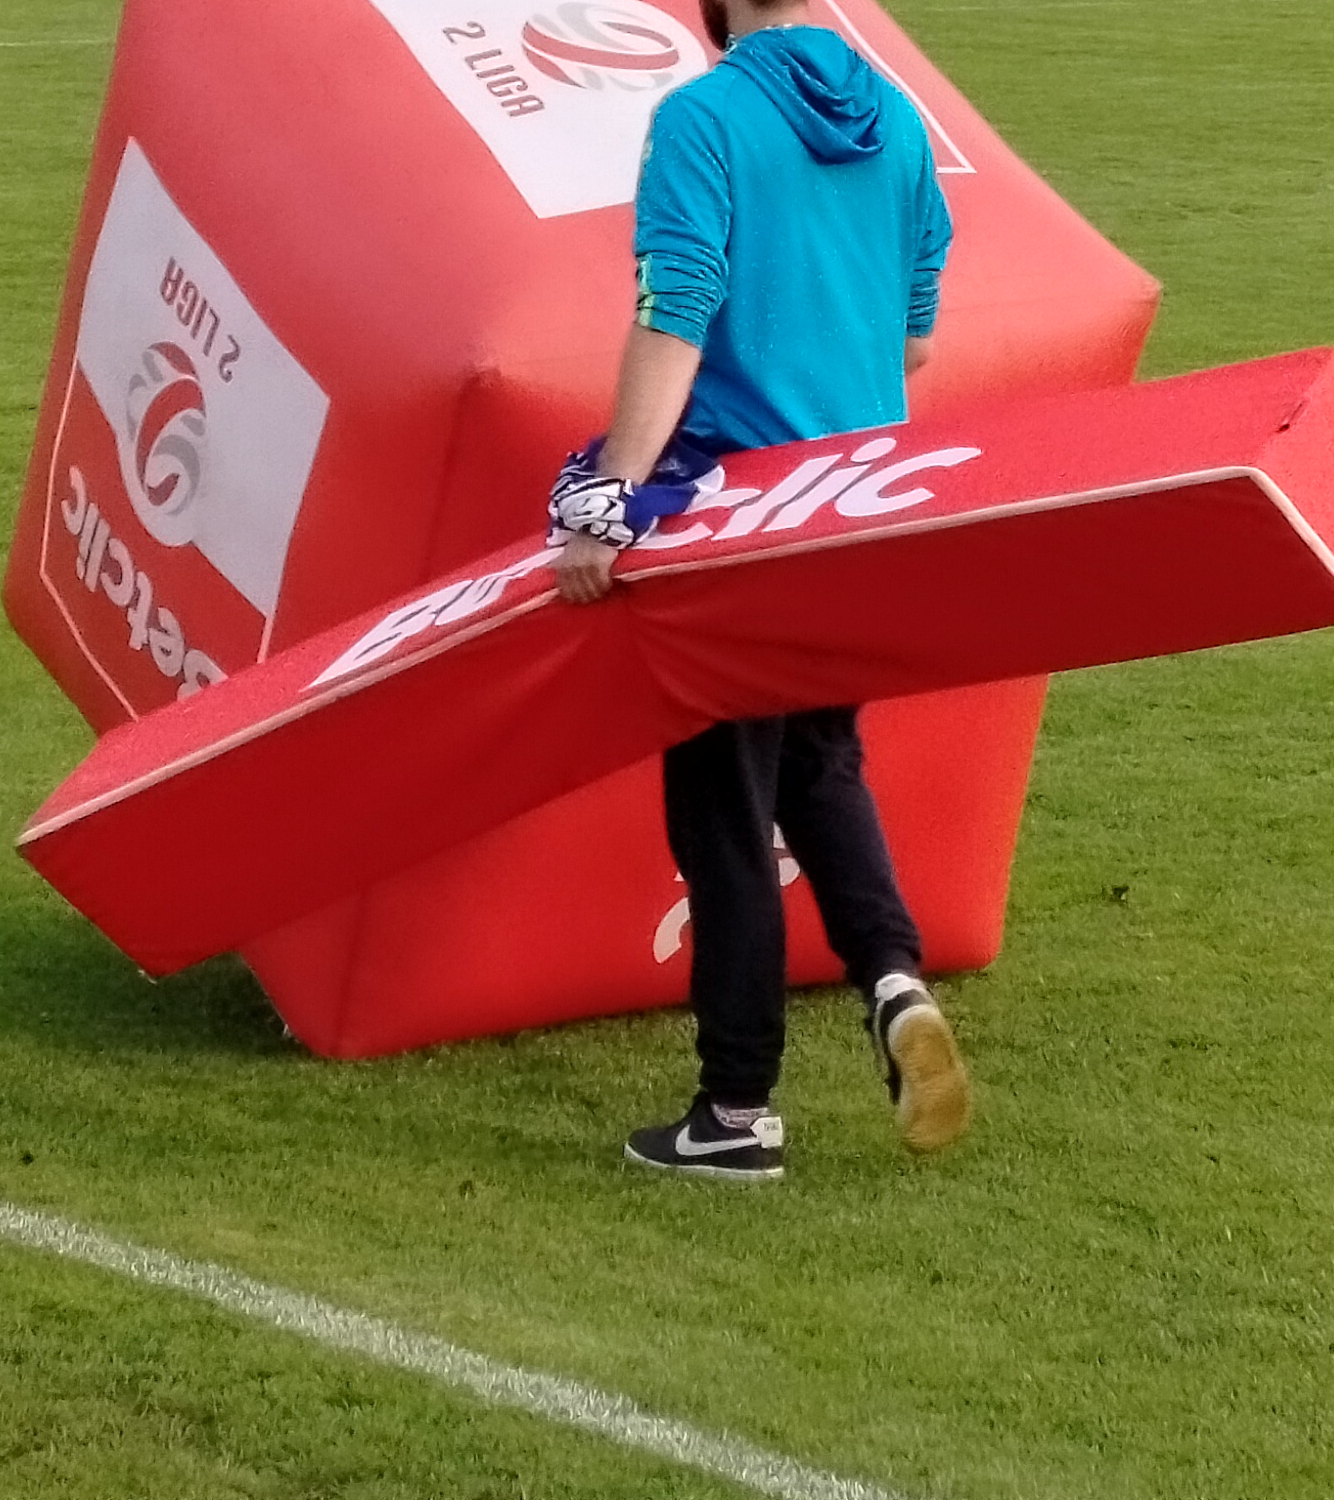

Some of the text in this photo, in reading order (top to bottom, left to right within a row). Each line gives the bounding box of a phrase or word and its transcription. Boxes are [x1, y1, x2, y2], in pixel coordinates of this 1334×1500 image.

[442, 20, 545, 118] 2 LIGA
[160, 256, 243, 384] 2 LIGA
